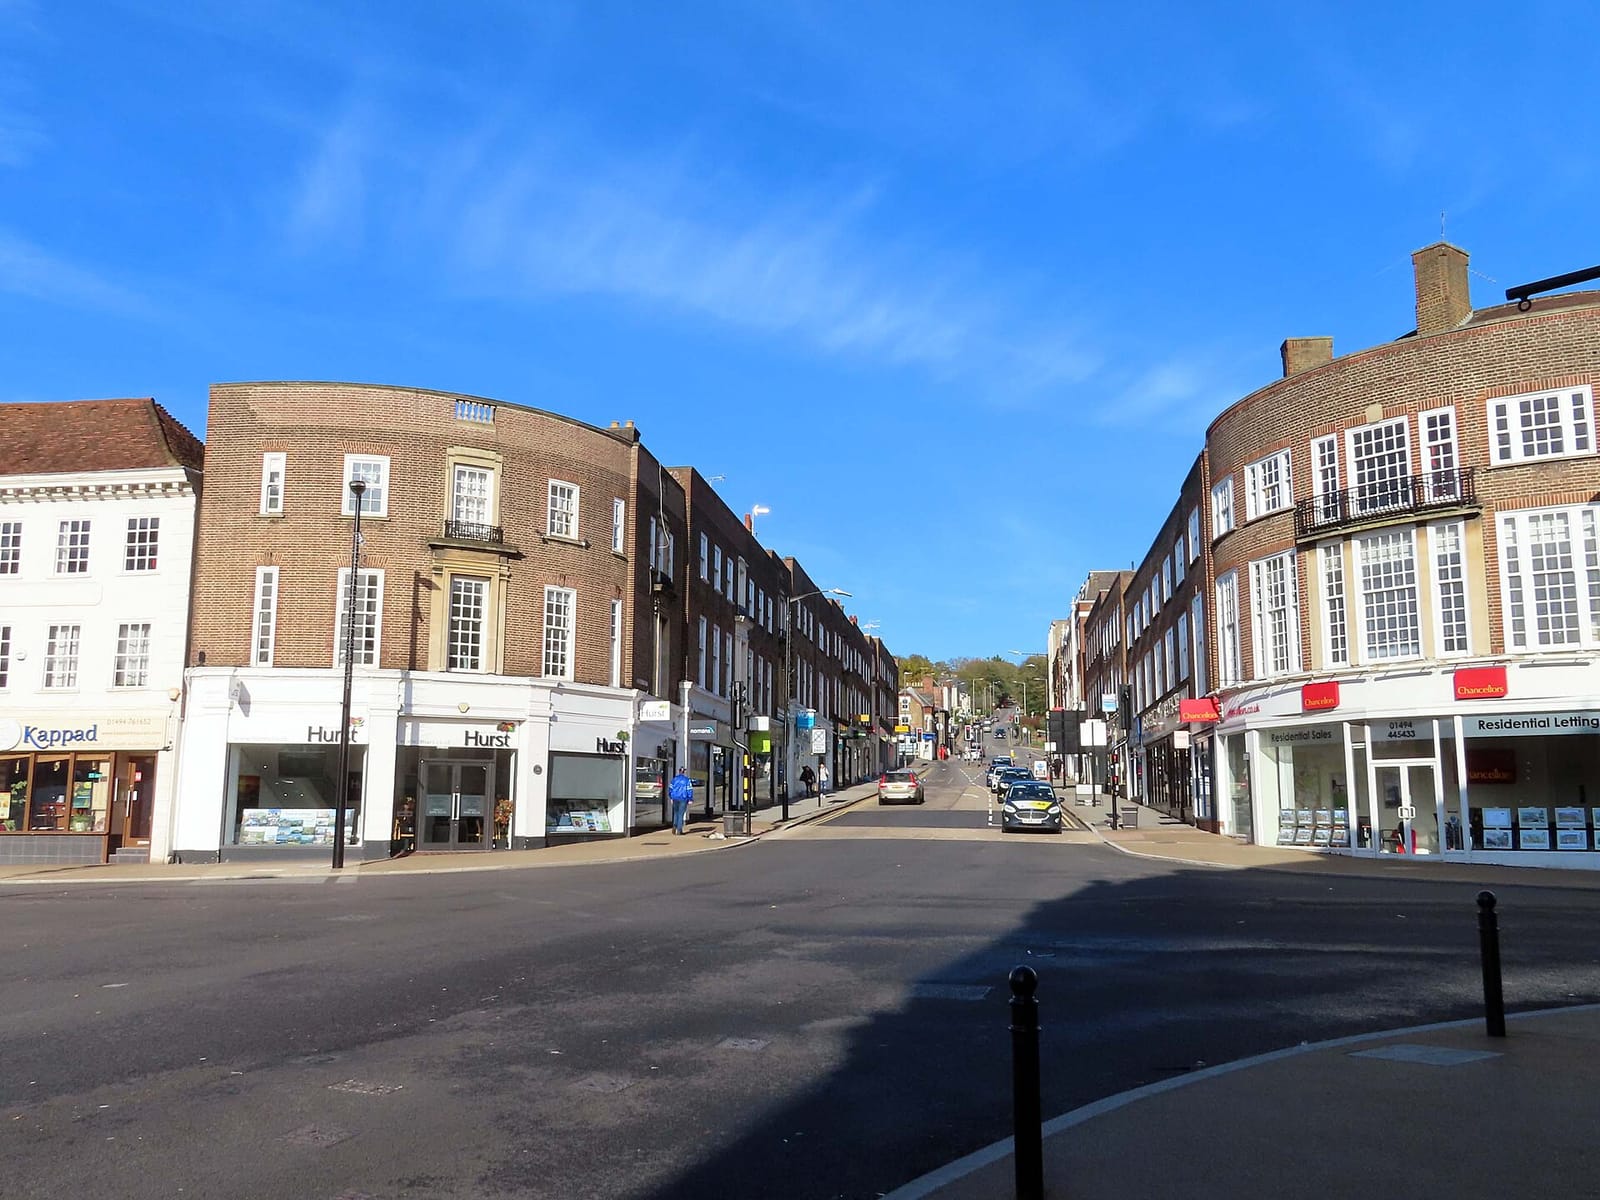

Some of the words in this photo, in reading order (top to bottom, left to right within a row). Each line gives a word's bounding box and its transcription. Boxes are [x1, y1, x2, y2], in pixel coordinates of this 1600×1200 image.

[1458, 685, 1505, 695] Chancellors
[1389, 722, 1413, 730] 01494
[1478, 717, 1550, 730] Residential
[23, 724, 98, 749] Kappad
[307, 725, 358, 743] Hurt
[464, 730, 511, 747] Hurst
[1271, 732, 1310, 743] Residential
[1311, 730, 1332, 740] Sales
[1387, 730, 1416, 738] 445433
[596, 737, 626, 753] Hurst
